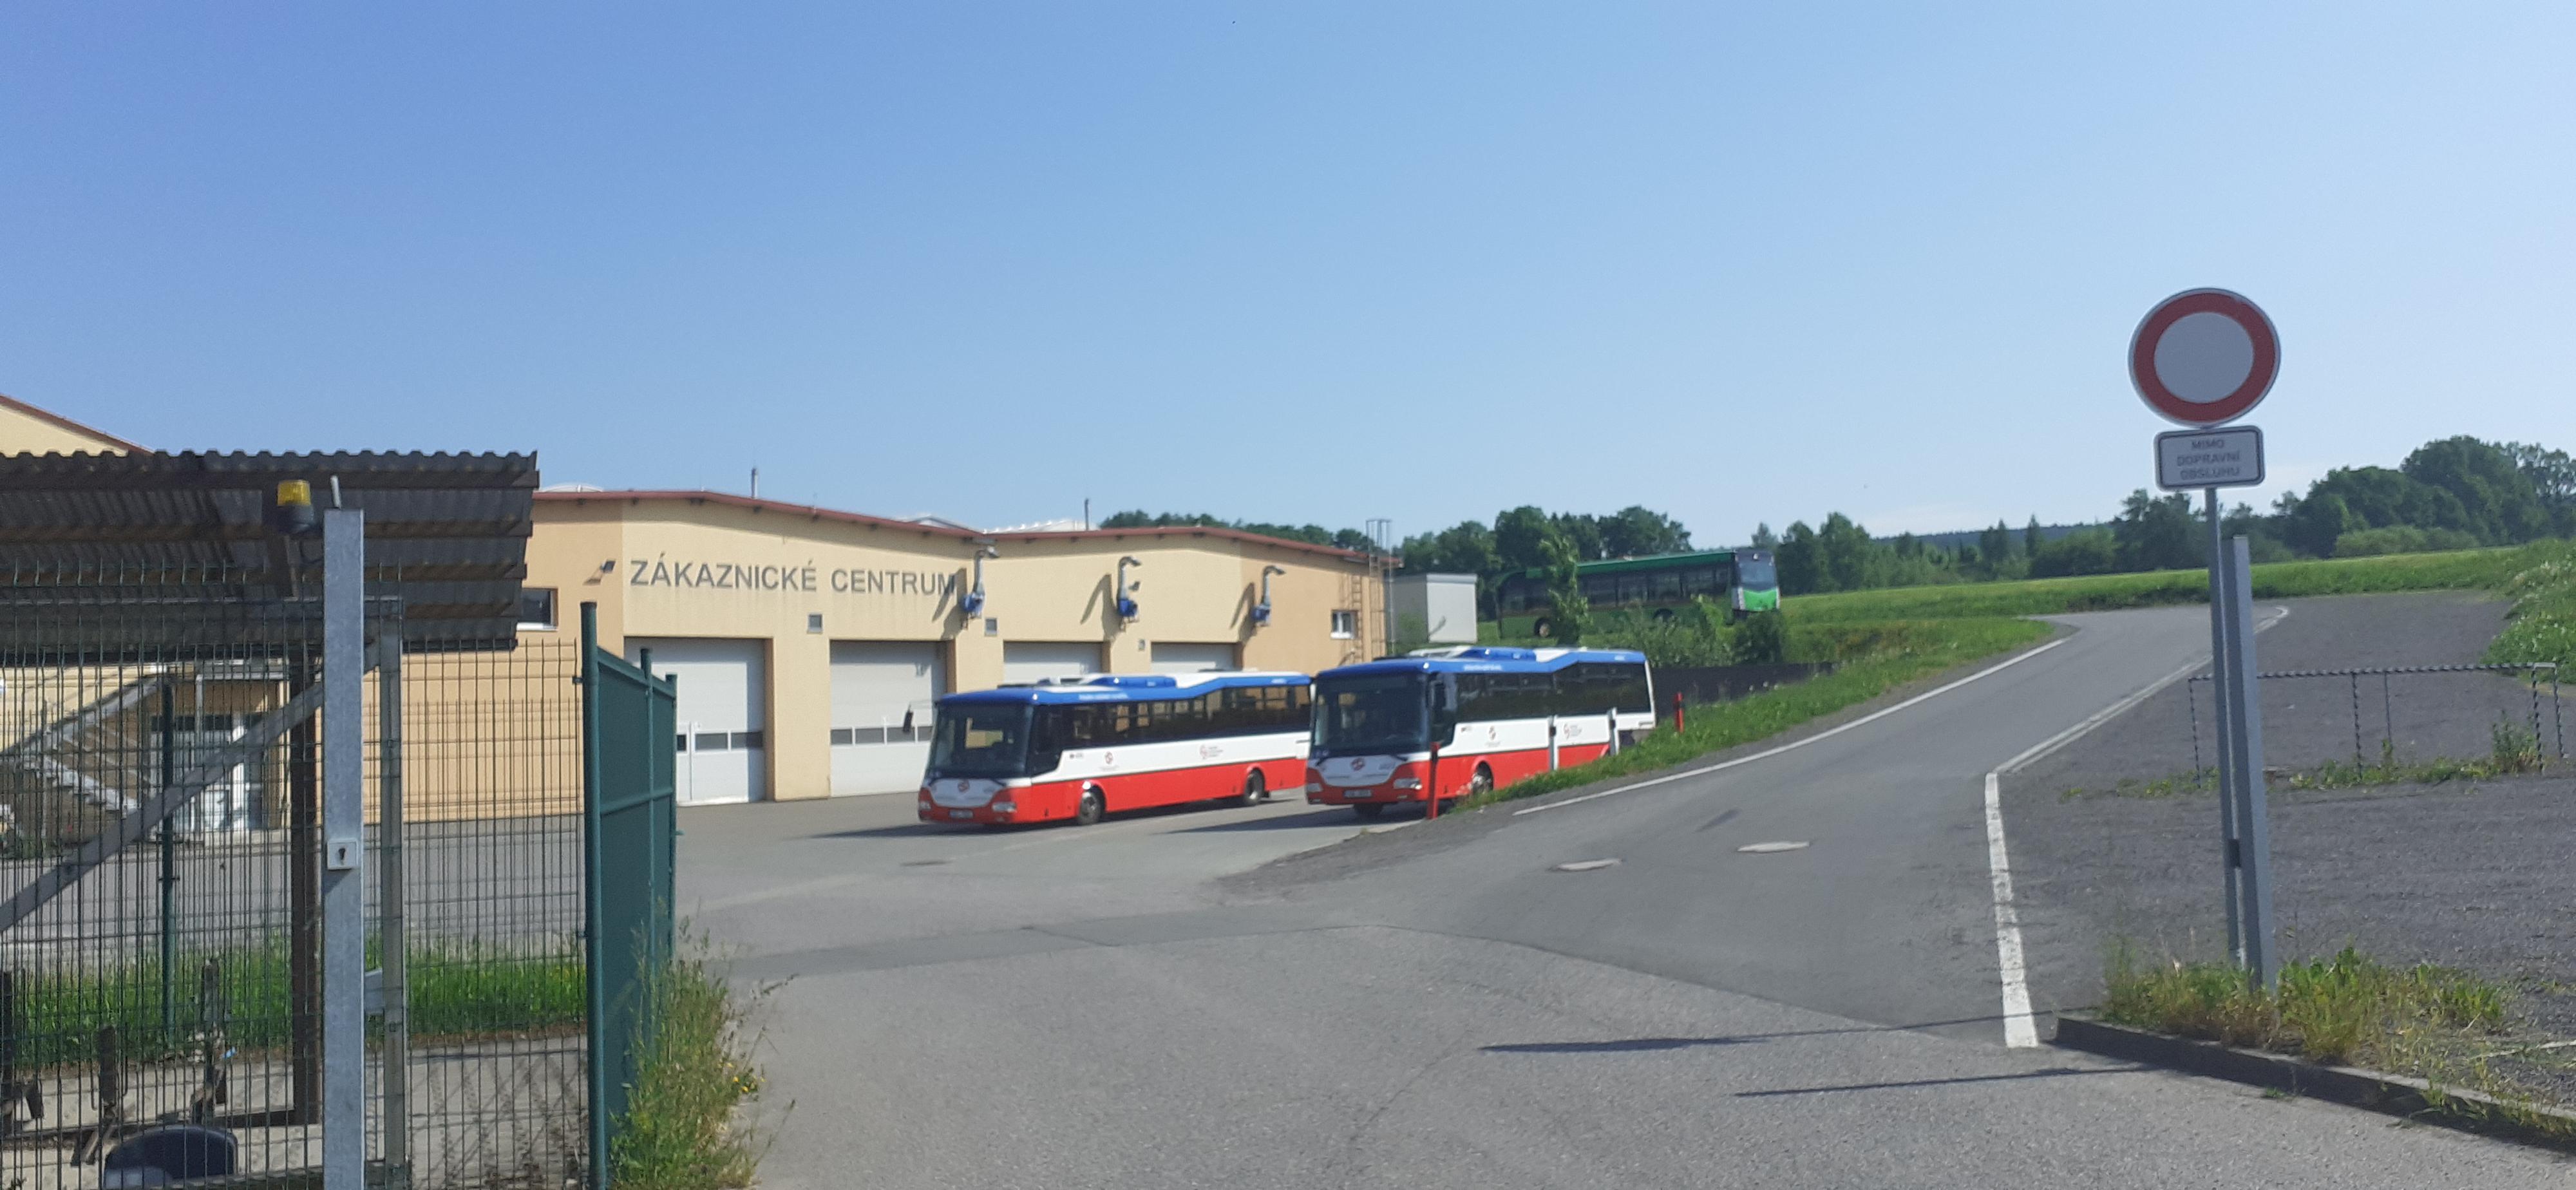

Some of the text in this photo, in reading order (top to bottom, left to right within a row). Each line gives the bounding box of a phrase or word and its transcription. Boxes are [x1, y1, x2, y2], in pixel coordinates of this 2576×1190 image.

[2192, 439, 2224, 449] MIMO
[2180, 467, 2240, 480] OBSLUHU
[630, 551, 956, 596] ZÁKAZNICKÉ CENTRUM
